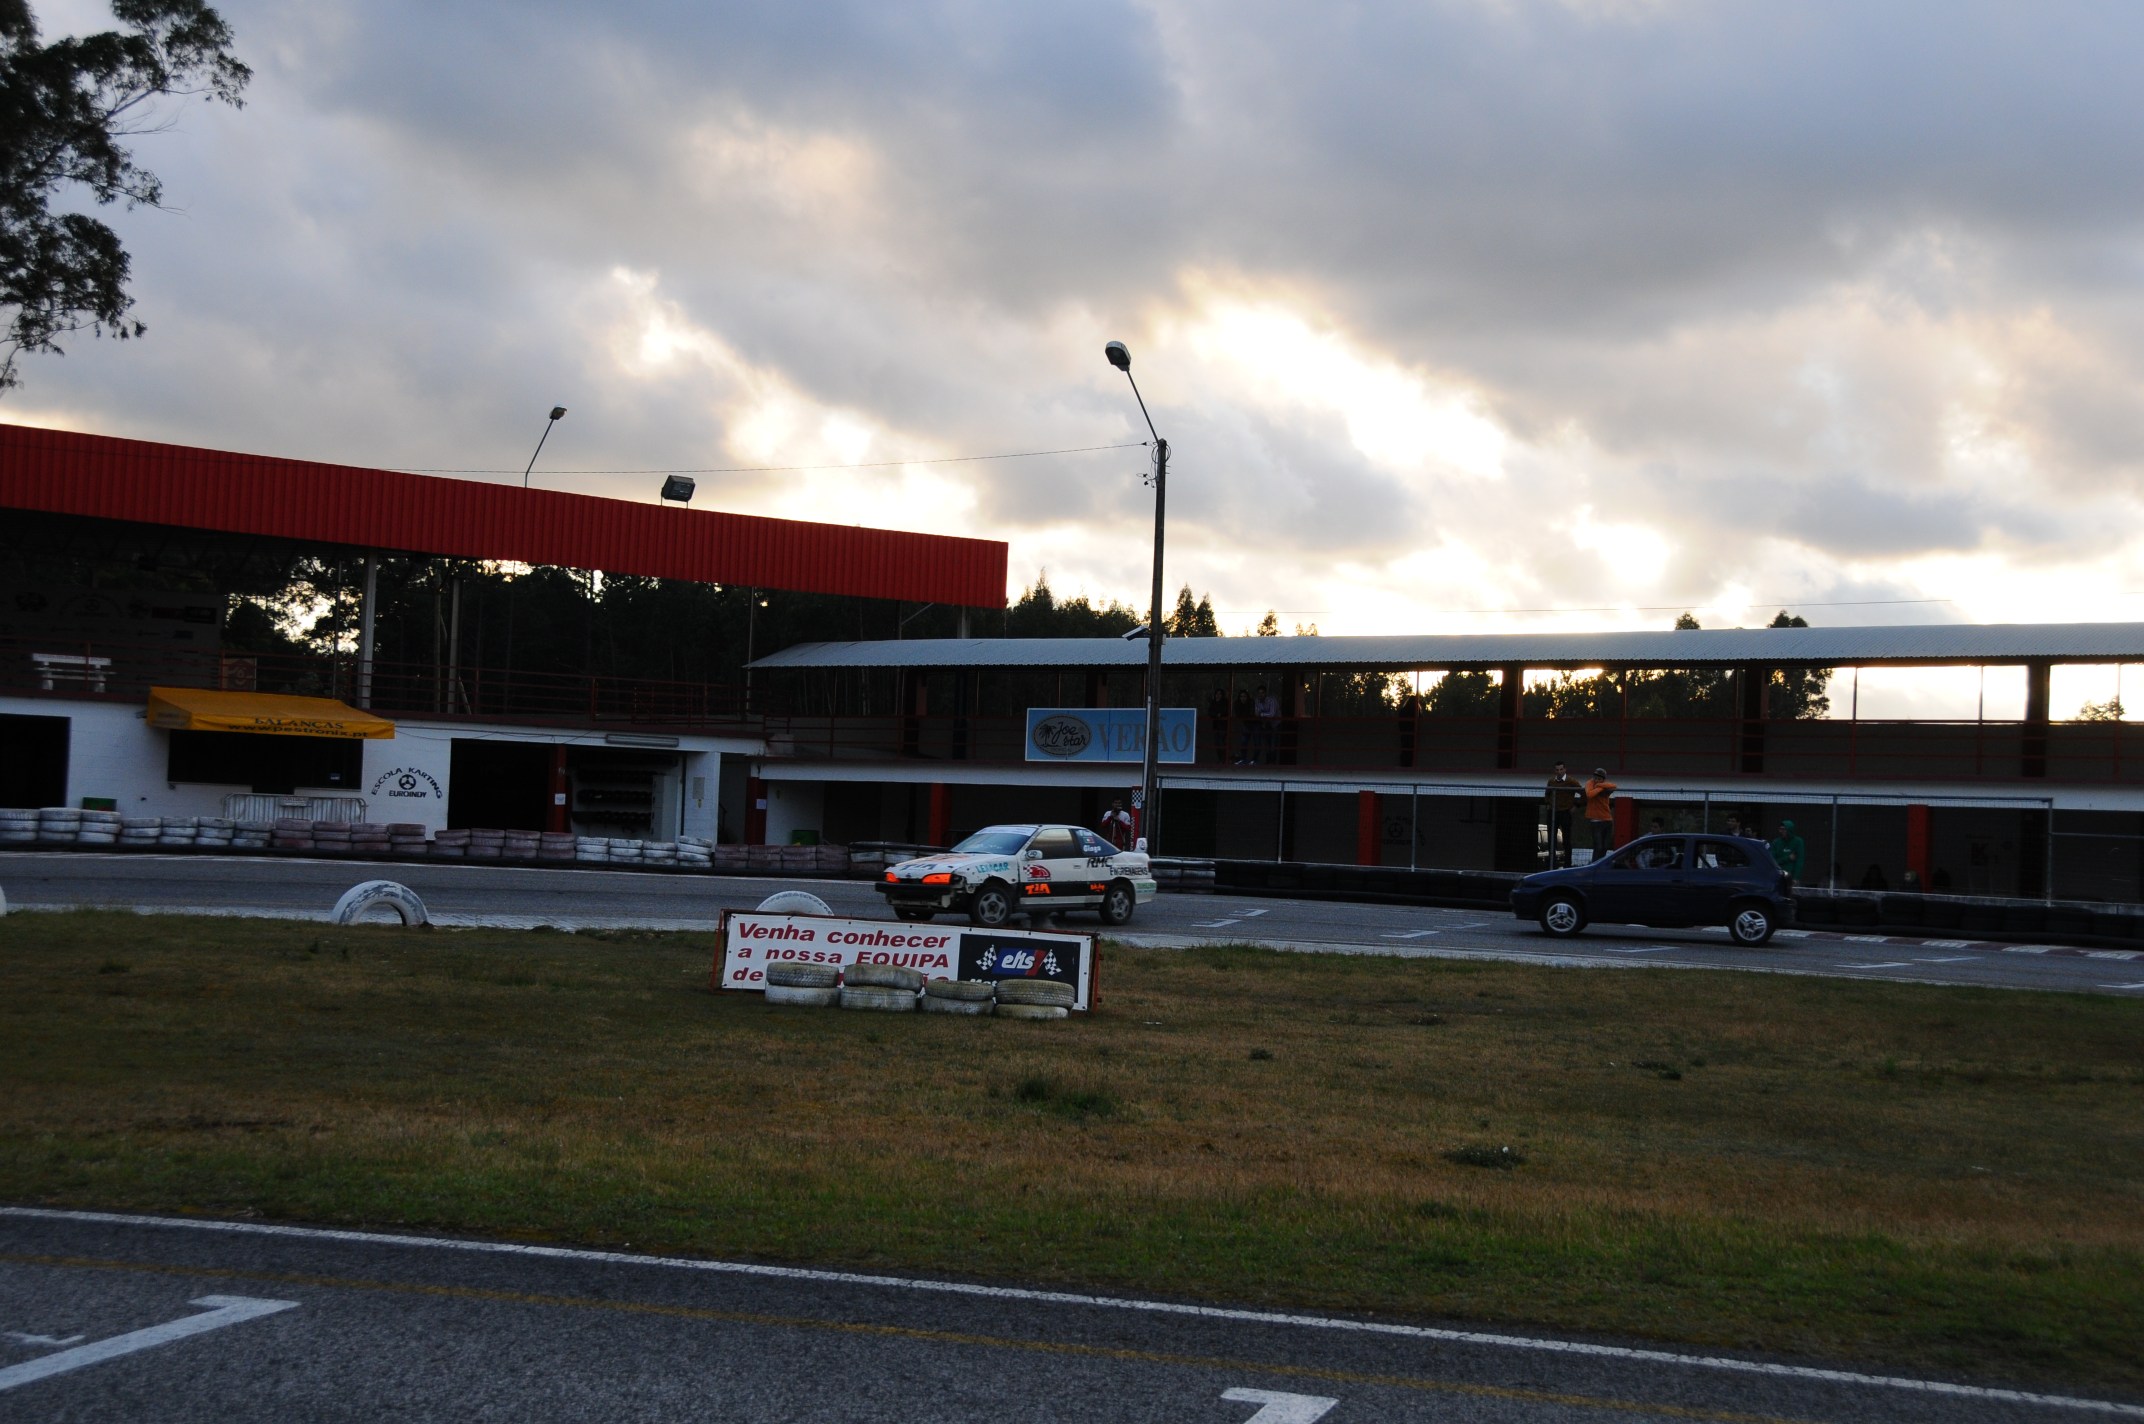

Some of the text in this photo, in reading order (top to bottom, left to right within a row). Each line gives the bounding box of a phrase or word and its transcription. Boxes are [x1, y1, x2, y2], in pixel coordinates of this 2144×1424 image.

[1052, 721, 1078, 744] Joe
[371, 767, 442, 799] ESCOLA KARTING
[388, 790, 427, 798] EUROINDY
[1086, 857, 1113, 868] RMC
[738, 922, 950, 948] Venha conhecer
[737, 947, 949, 968] a nossa EQUIPA
[732, 967, 763, 981] de
